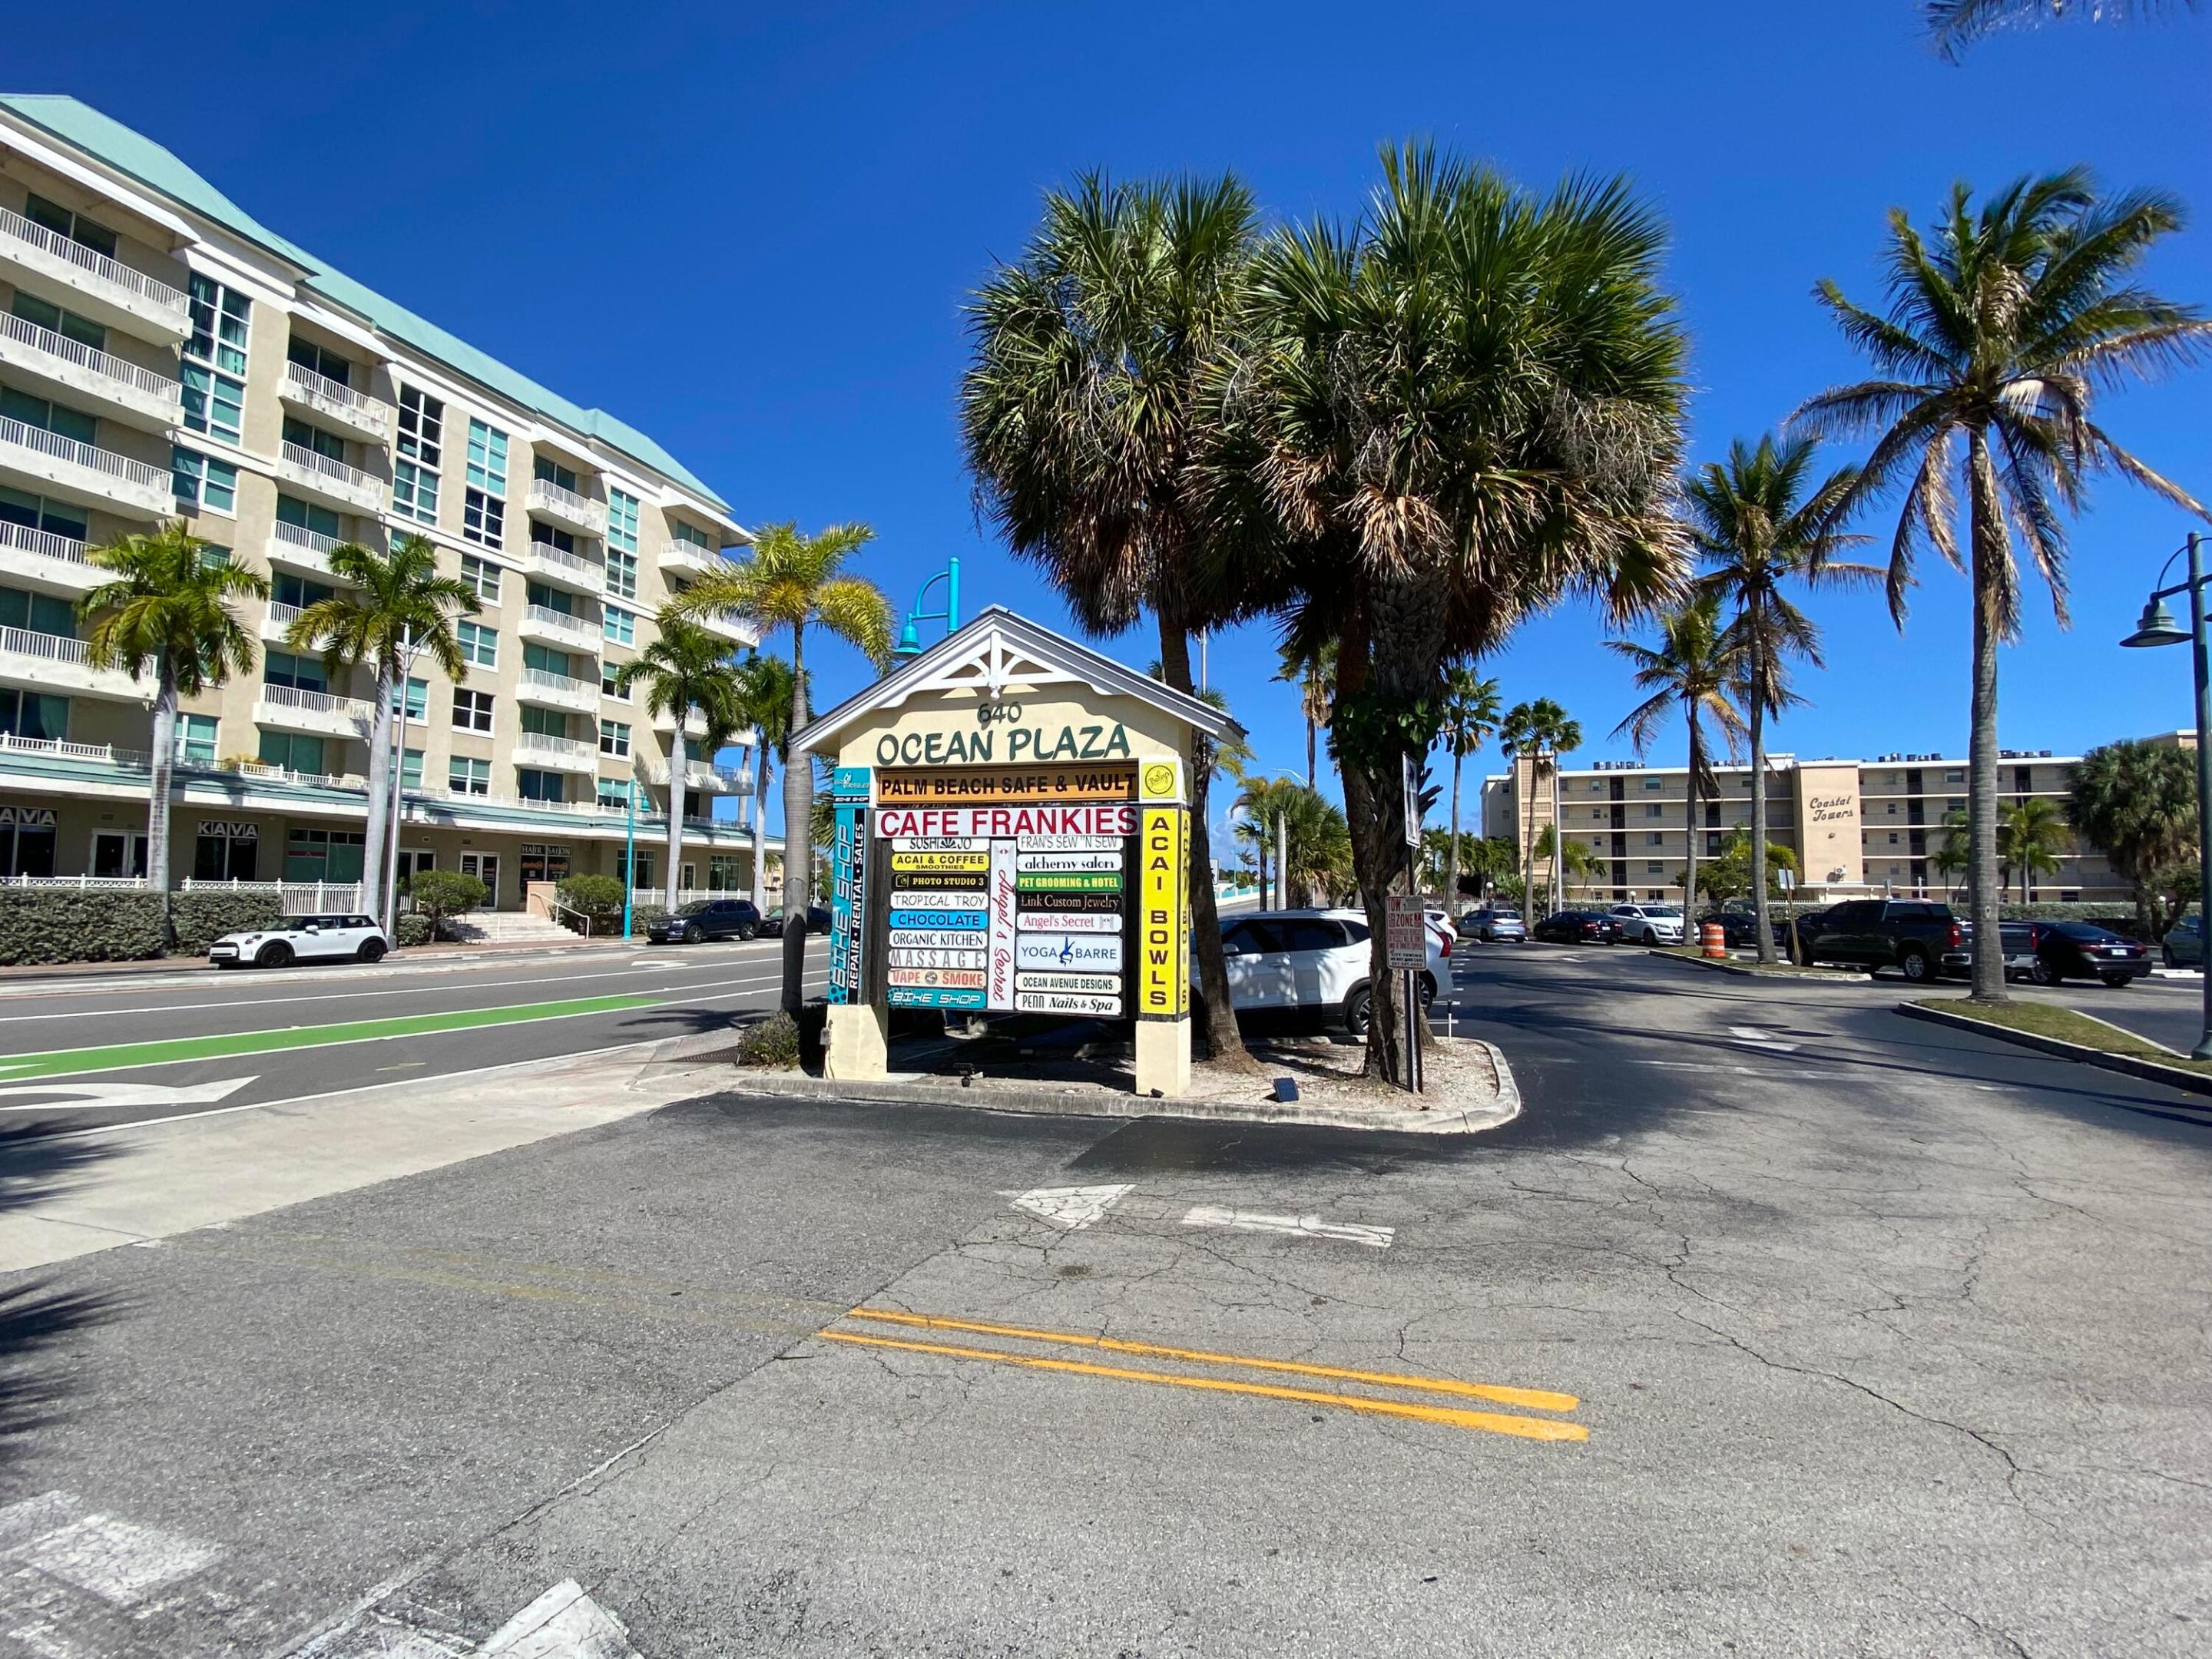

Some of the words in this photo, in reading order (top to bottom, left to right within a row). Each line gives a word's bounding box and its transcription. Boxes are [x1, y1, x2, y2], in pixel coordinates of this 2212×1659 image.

[977, 701, 1022, 724] 640
[876, 730, 993, 766] OCEAN
[1007, 724, 1131, 761] PLAZA
[882, 779, 927, 796] PALM
[934, 777, 995, 795] BEACH
[1002, 776, 1048, 793] SAFE
[1055, 775, 1068, 792] &
[1075, 773, 1136, 792] VAULT
[1810, 796, 1852, 809] Coastal
[880, 811, 959, 837] CAFE
[972, 807, 1137, 836] FRANKIES
[1813, 810, 1853, 822] Towers
[197, 822, 257, 836] KAVA
[855, 823, 864, 865] SALES
[909, 837, 939, 849] SUSHI
[958, 837, 972, 849] JO
[1021, 836, 1053, 848] FRAN'S
[1056, 836, 1078, 848] SEW
[1095, 836, 1117, 848] SEW
[522, 846, 542, 854] HAIR
[547, 846, 570, 855] SALON
[1150, 817, 1170, 890] ACAI
[837, 824, 852, 901] SHOP
[897, 856, 922, 864] ACAI
[928, 856, 935, 864] &
[939, 856, 984, 864] COFFEE
[1025, 856, 1078, 871] alchemy
[1081, 856, 1114, 869] salon
[1019, 878, 1034, 887] PET
[1036, 878, 1082, 887] GROOMING
[1084, 879, 1090, 887] &
[1091, 878, 1118, 887] HOTEL
[852, 876, 863, 929] RENTAL
[894, 895, 950, 906] TROPICAL
[954, 896, 985, 906] TROY
[1021, 894, 1042, 907] Link
[1045, 895, 1081, 907] Custom
[1082, 895, 1119, 911] Jewelry
[1387, 899, 1401, 912] TOW
[899, 914, 980, 926] CHOCOLATE
[1023, 915, 1059, 929] Angel's
[1061, 915, 1094, 927] Secret
[1396, 914, 1413, 927] ZONE
[893, 933, 936, 945] ORGANIC
[940, 934, 983, 945] KITCHEN
[891, 949, 982, 969] MASSAGE
[1022, 947, 1058, 957] YOGA
[1075, 949, 1117, 959] BARRE
[1149, 910, 1168, 1005] BOWLS
[849, 941, 859, 988] REPAIR
[892, 972, 920, 983] VAPE
[942, 972, 983, 985] SMOKE
[992, 946, 1011, 1002] Secret
[1023, 977, 1048, 987] OCEAN
[1050, 978, 1079, 988] AVENUE
[1081, 979, 1113, 989] DESIGNS
[892, 992, 933, 1002] BIKE
[939, 995, 980, 1004] SHOP
[1049, 997, 1078, 1008] Nails
[1081, 999, 1087, 1008] &
[1089, 998, 1113, 1012] Spa
